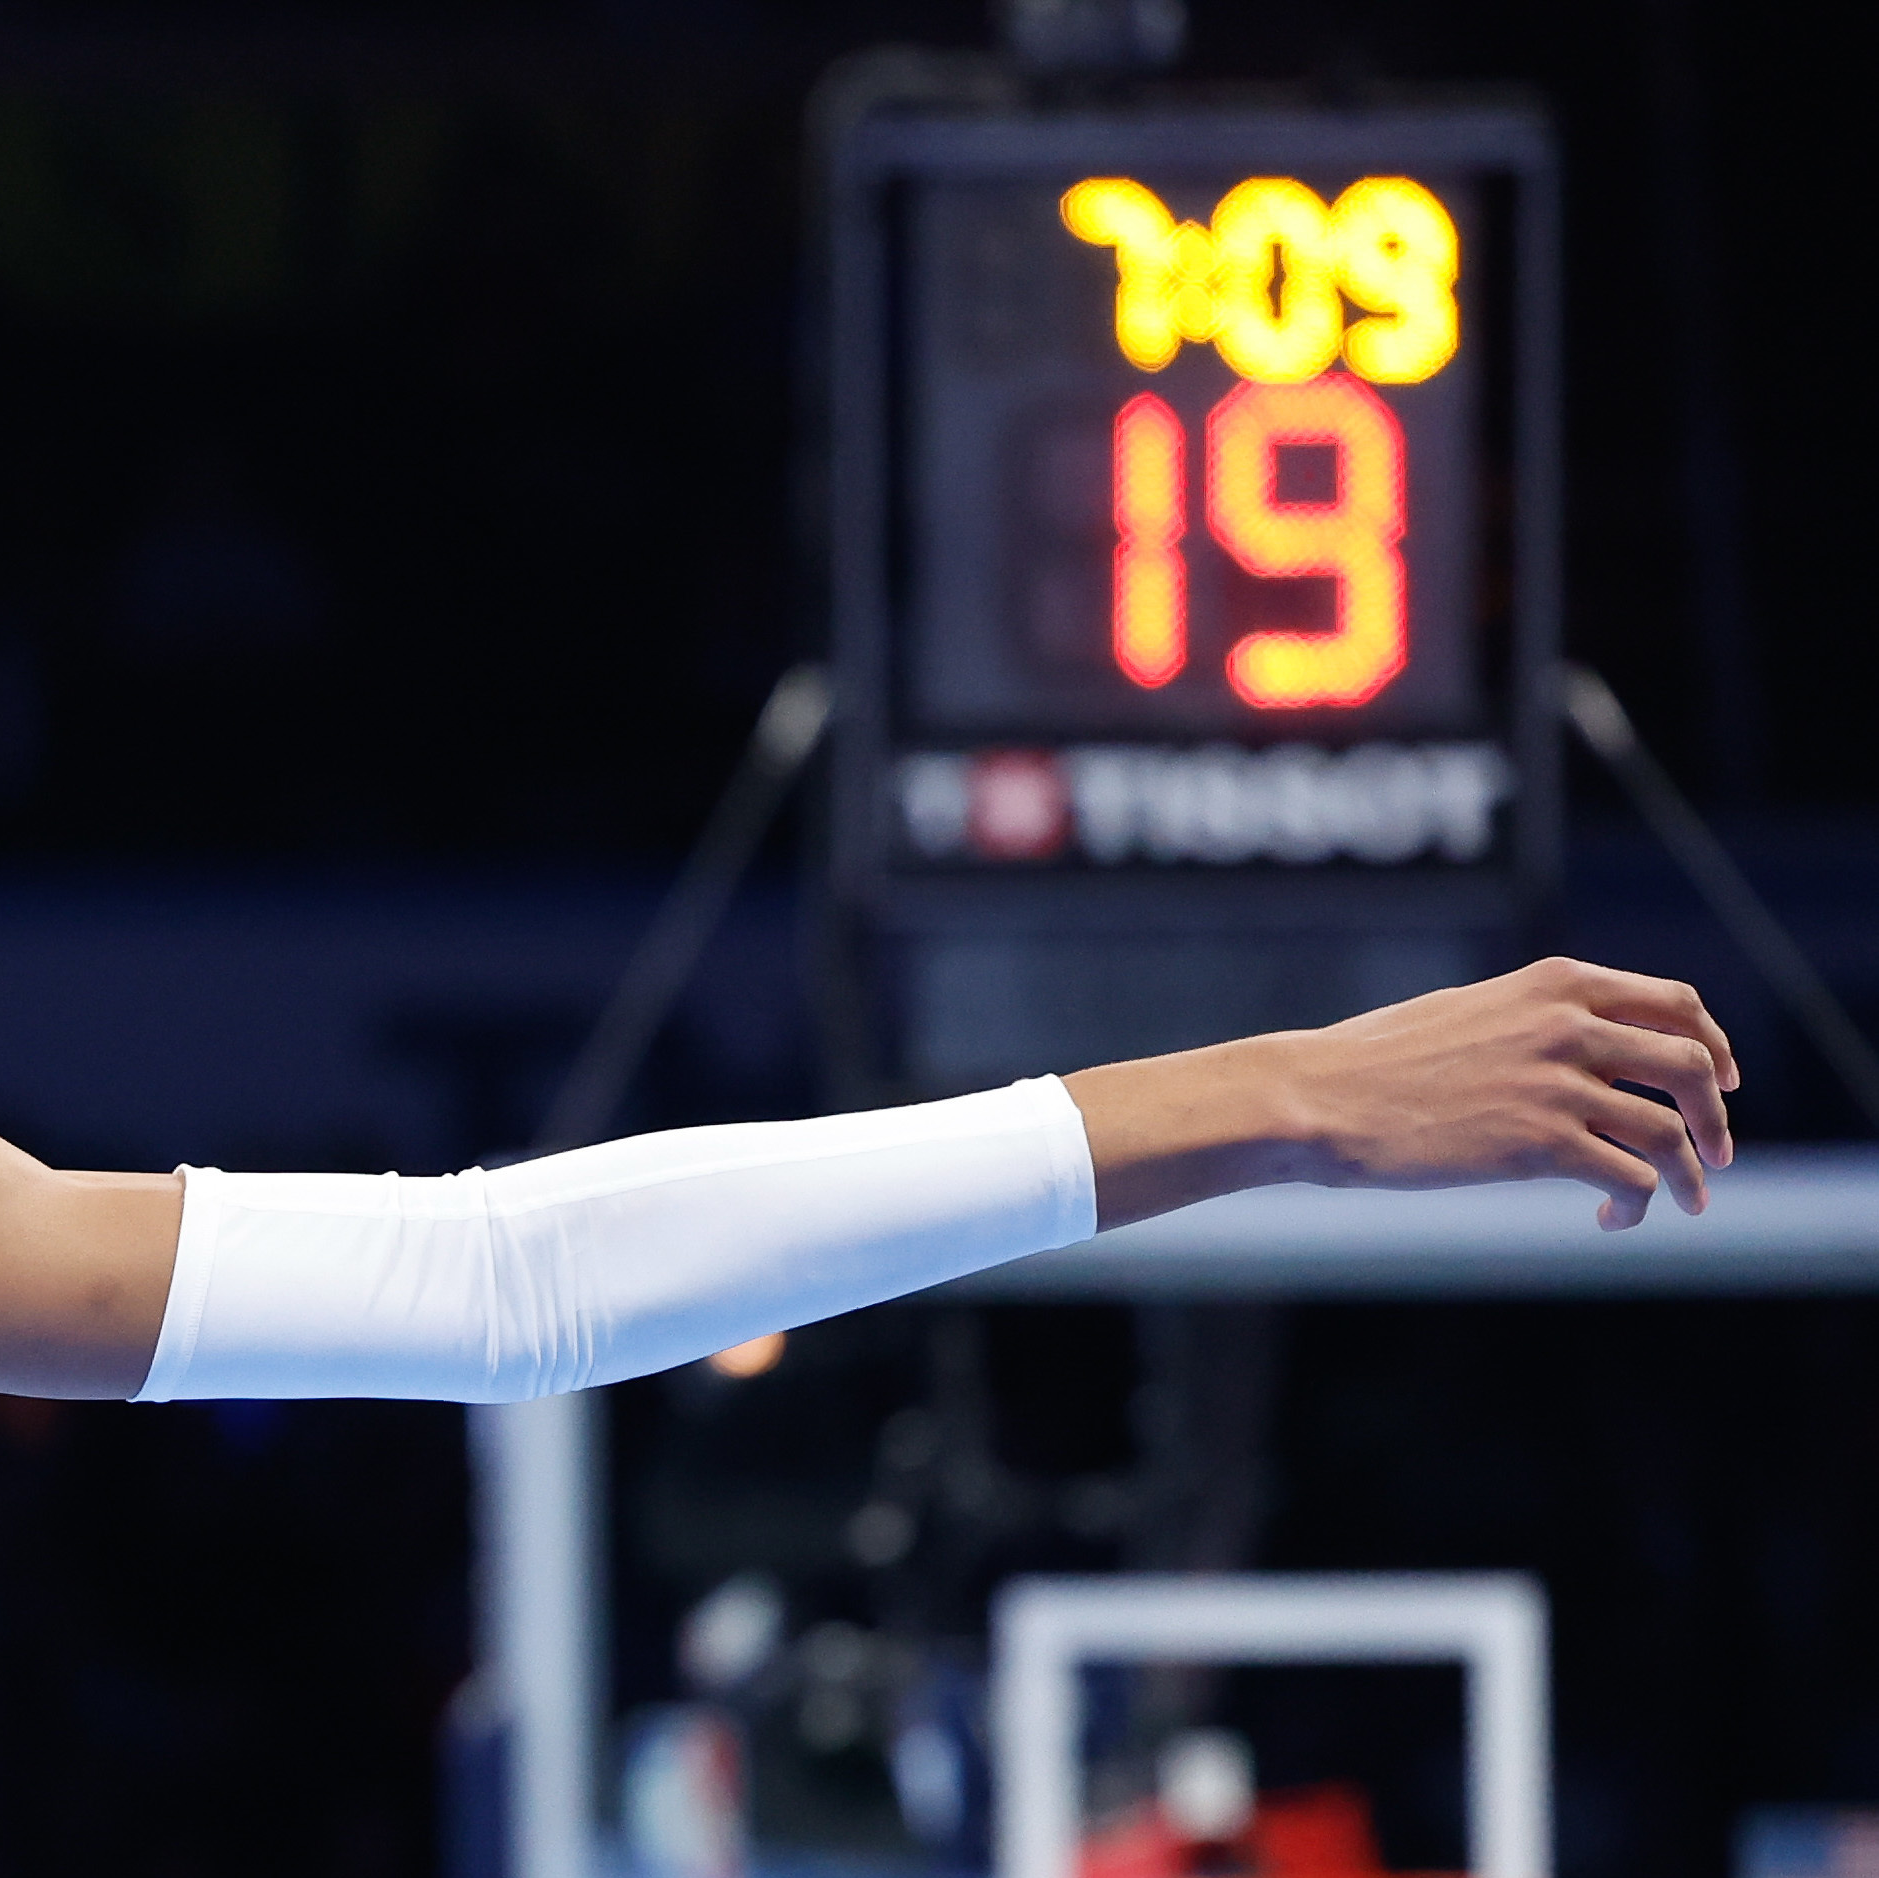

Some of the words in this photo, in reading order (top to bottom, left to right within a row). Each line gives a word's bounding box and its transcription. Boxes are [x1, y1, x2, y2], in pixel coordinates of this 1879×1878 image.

[1061, 176, 1458, 384] 7:09
[1113, 372, 1408, 708] 19
[1075, 742, 1511, 866] TISSOT
